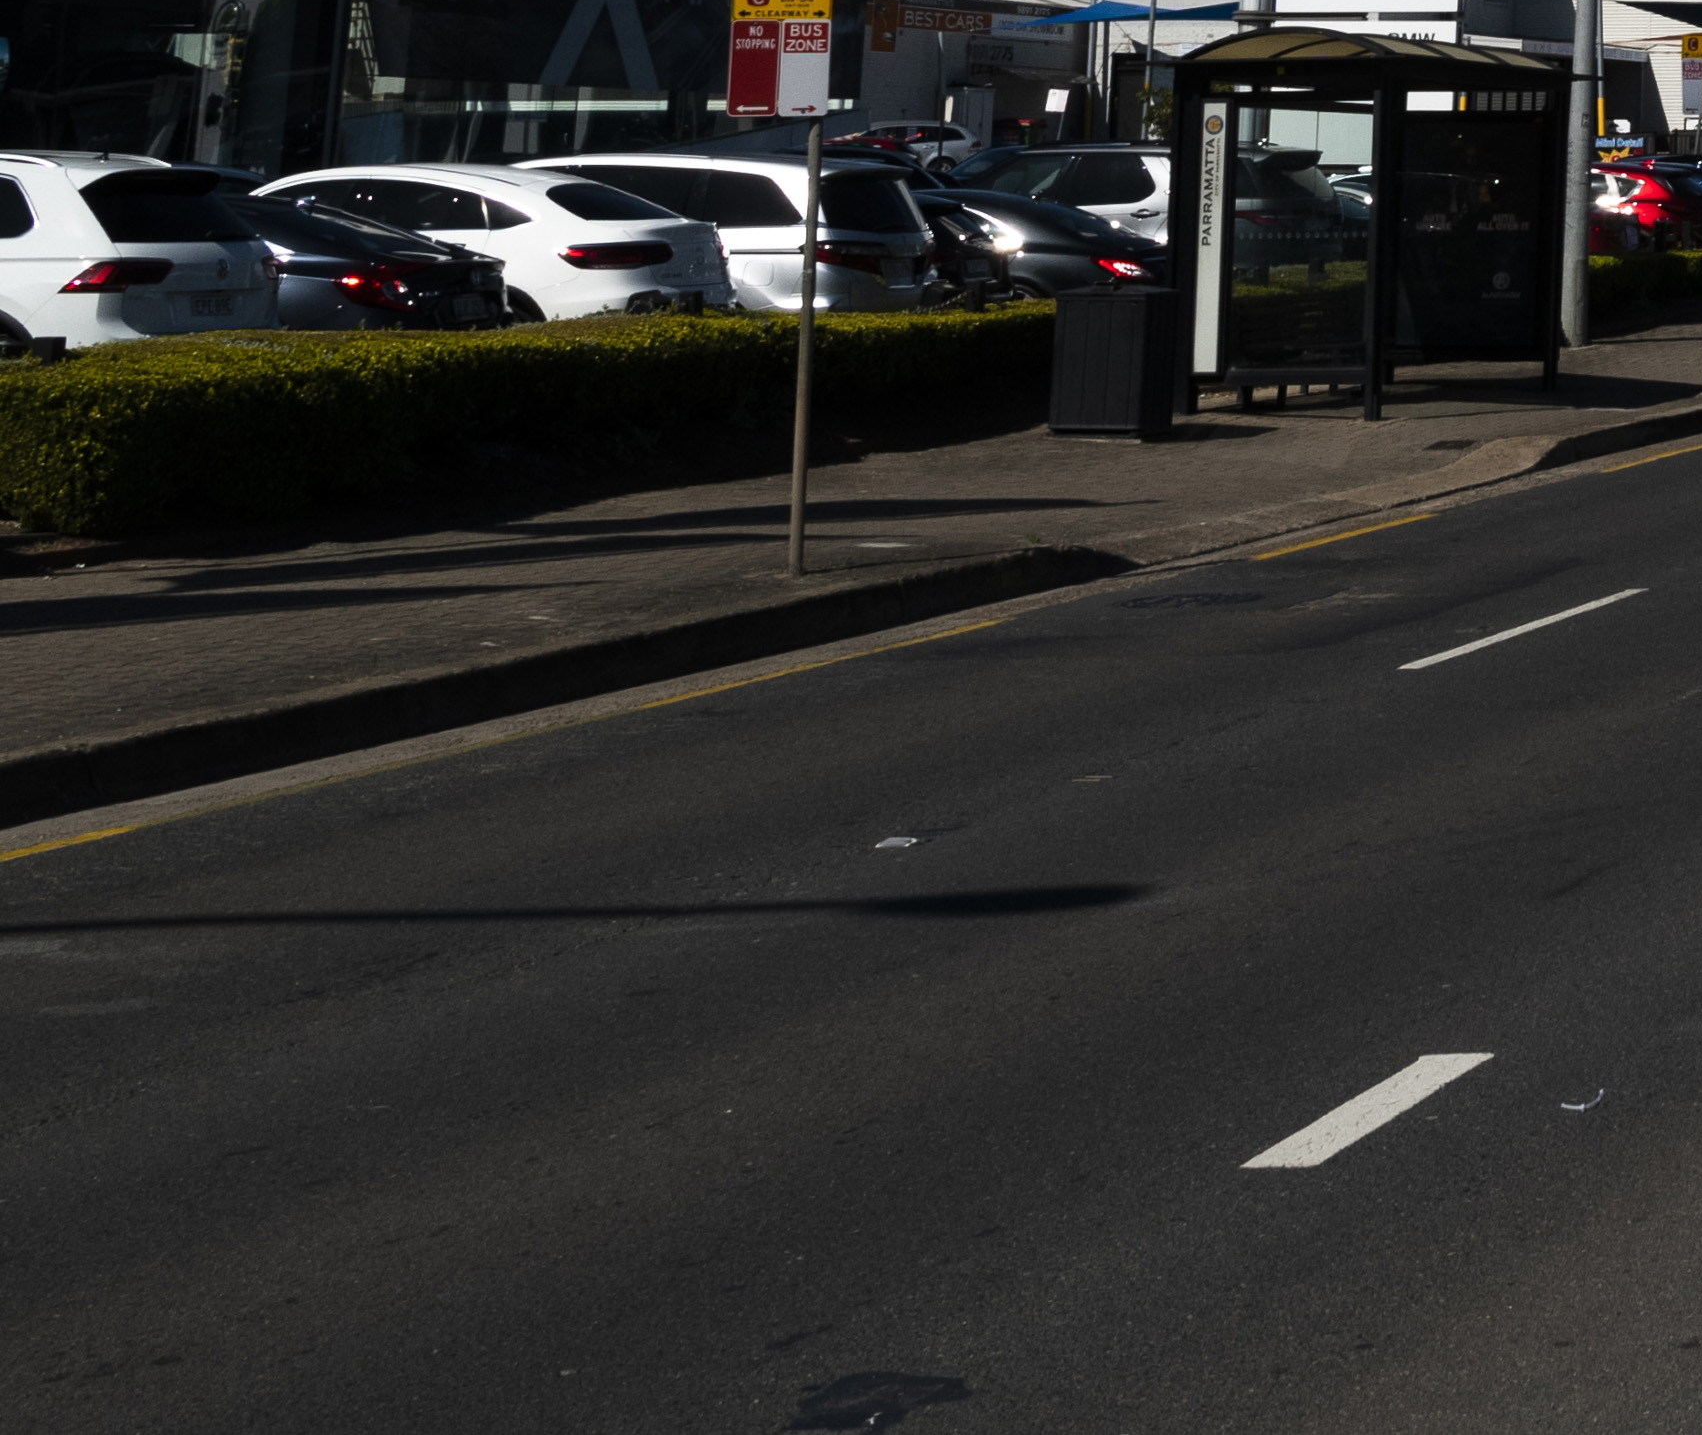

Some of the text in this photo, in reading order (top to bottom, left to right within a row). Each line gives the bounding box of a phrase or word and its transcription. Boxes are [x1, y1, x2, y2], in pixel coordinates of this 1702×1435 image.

[904, 10, 984, 31] BEST CARS
[749, 25, 764, 37] NO
[789, 24, 823, 37] BUS
[735, 38, 776, 50] STOPPING
[785, 39, 827, 52] ZONE
[1684, 63, 1700, 71] BUS
[1594, 137, 1644, 148] Mini Detail
[1201, 138, 1216, 246] PARRAMATTA
